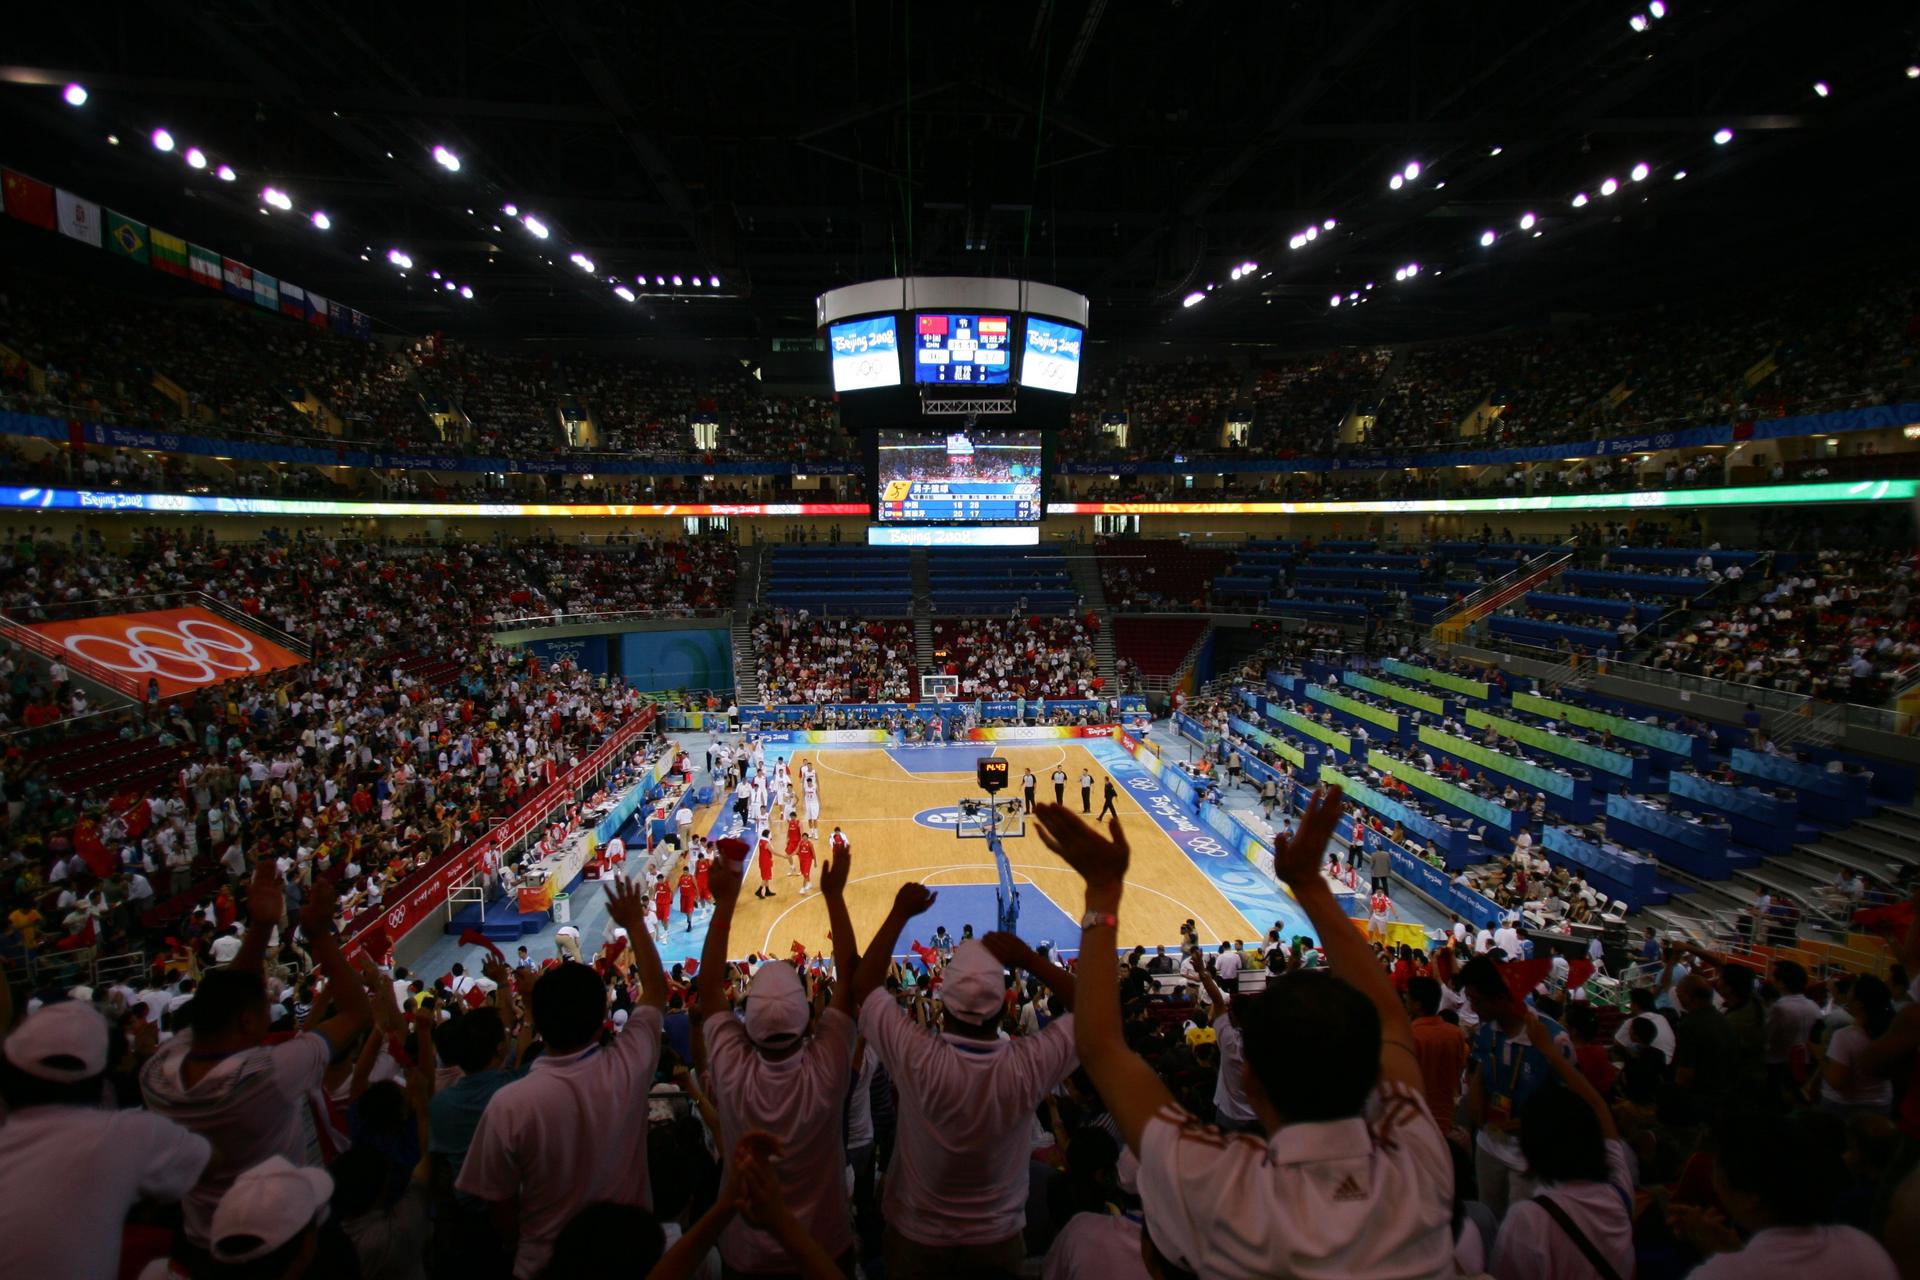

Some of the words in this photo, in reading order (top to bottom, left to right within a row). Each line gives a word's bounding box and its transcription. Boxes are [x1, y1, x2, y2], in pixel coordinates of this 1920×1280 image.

[832, 333, 868, 352] Beijing
[868, 329, 895, 346] 2008
[923, 333, 941, 342] 中国
[1028, 329, 1058, 354] Beijing
[1058, 338, 1080, 356] 2008
[77, 491, 117, 509] Beijing
[118, 494, 143, 508] 2008
[904, 501, 919, 509] 中国
[1018, 501, 1029, 509] 46
[710, 504, 739, 514] Beijing
[1018, 510, 1029, 518] 37
[888, 528, 931, 546] Beijing
[934, 530, 972, 543] 2008
[1086, 726, 1107, 736] Beijing
[1149, 795, 1180, 816] Beijing
